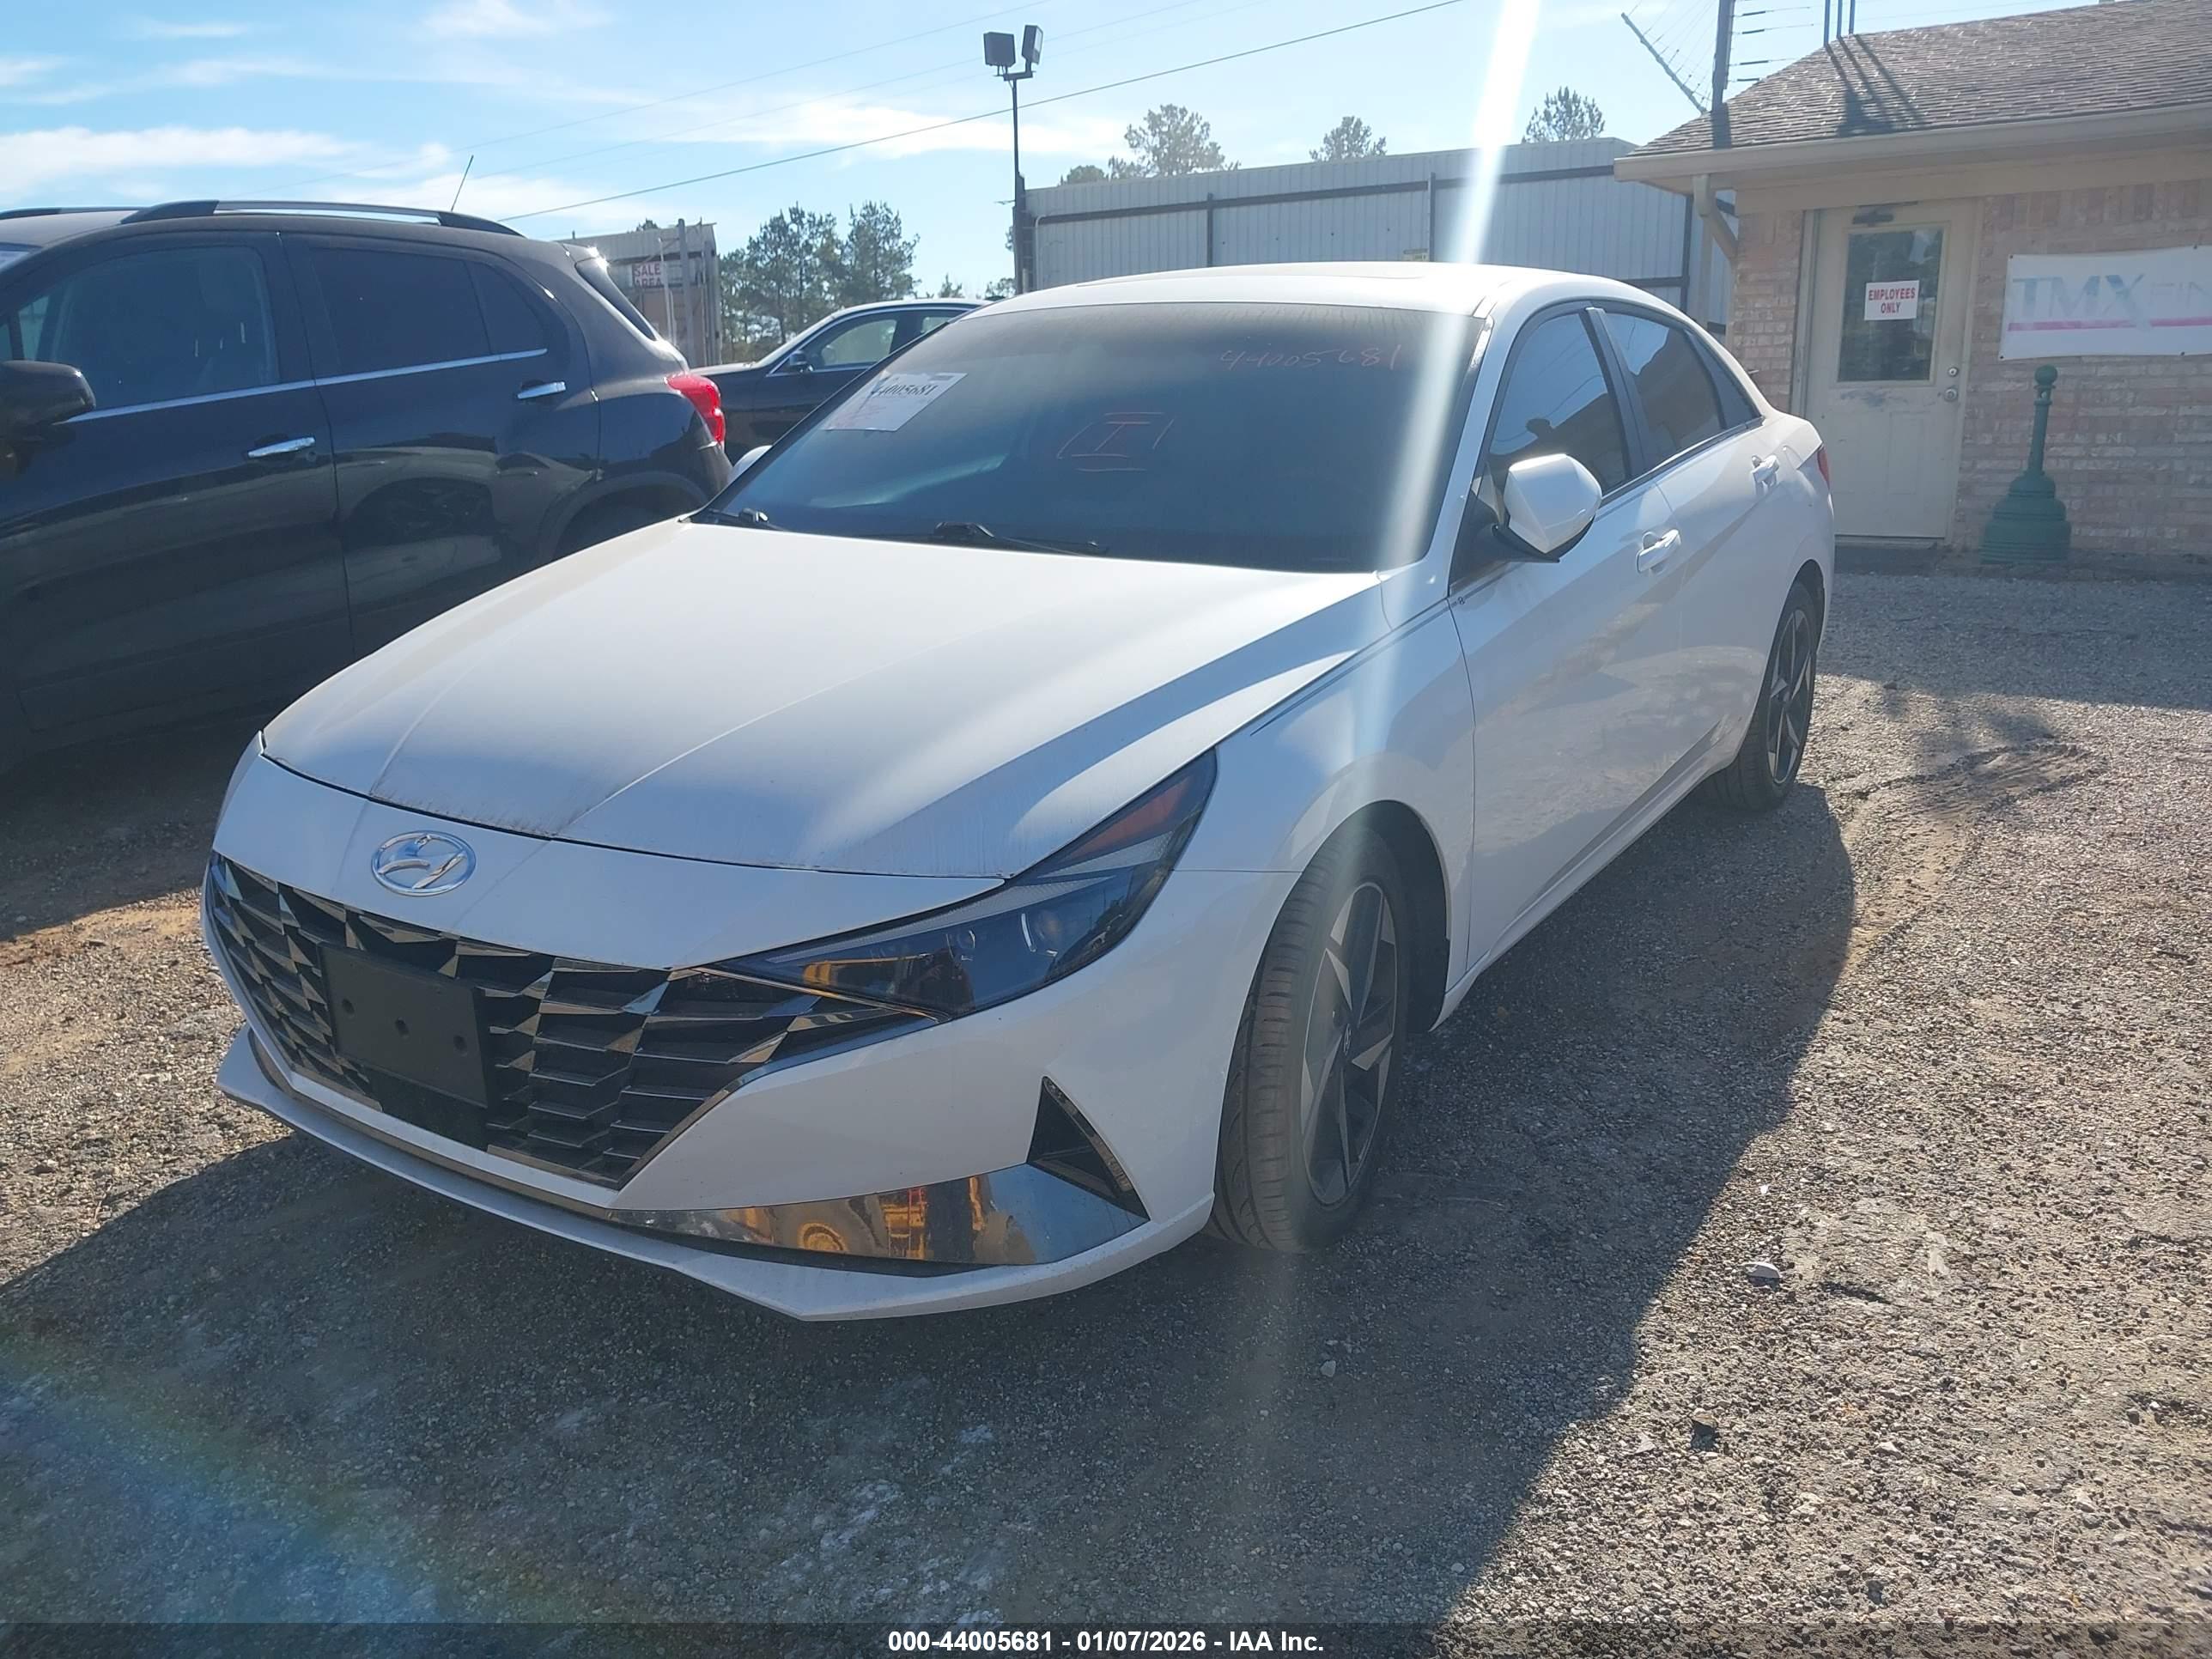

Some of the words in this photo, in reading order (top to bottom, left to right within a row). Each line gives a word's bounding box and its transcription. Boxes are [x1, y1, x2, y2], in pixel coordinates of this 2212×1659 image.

[634, 263, 660, 276] SALE
[1869, 288, 1916, 301] EMPLOYEES
[2012, 273, 2146, 319] TMX
[1881, 302, 1900, 313] ONLY
